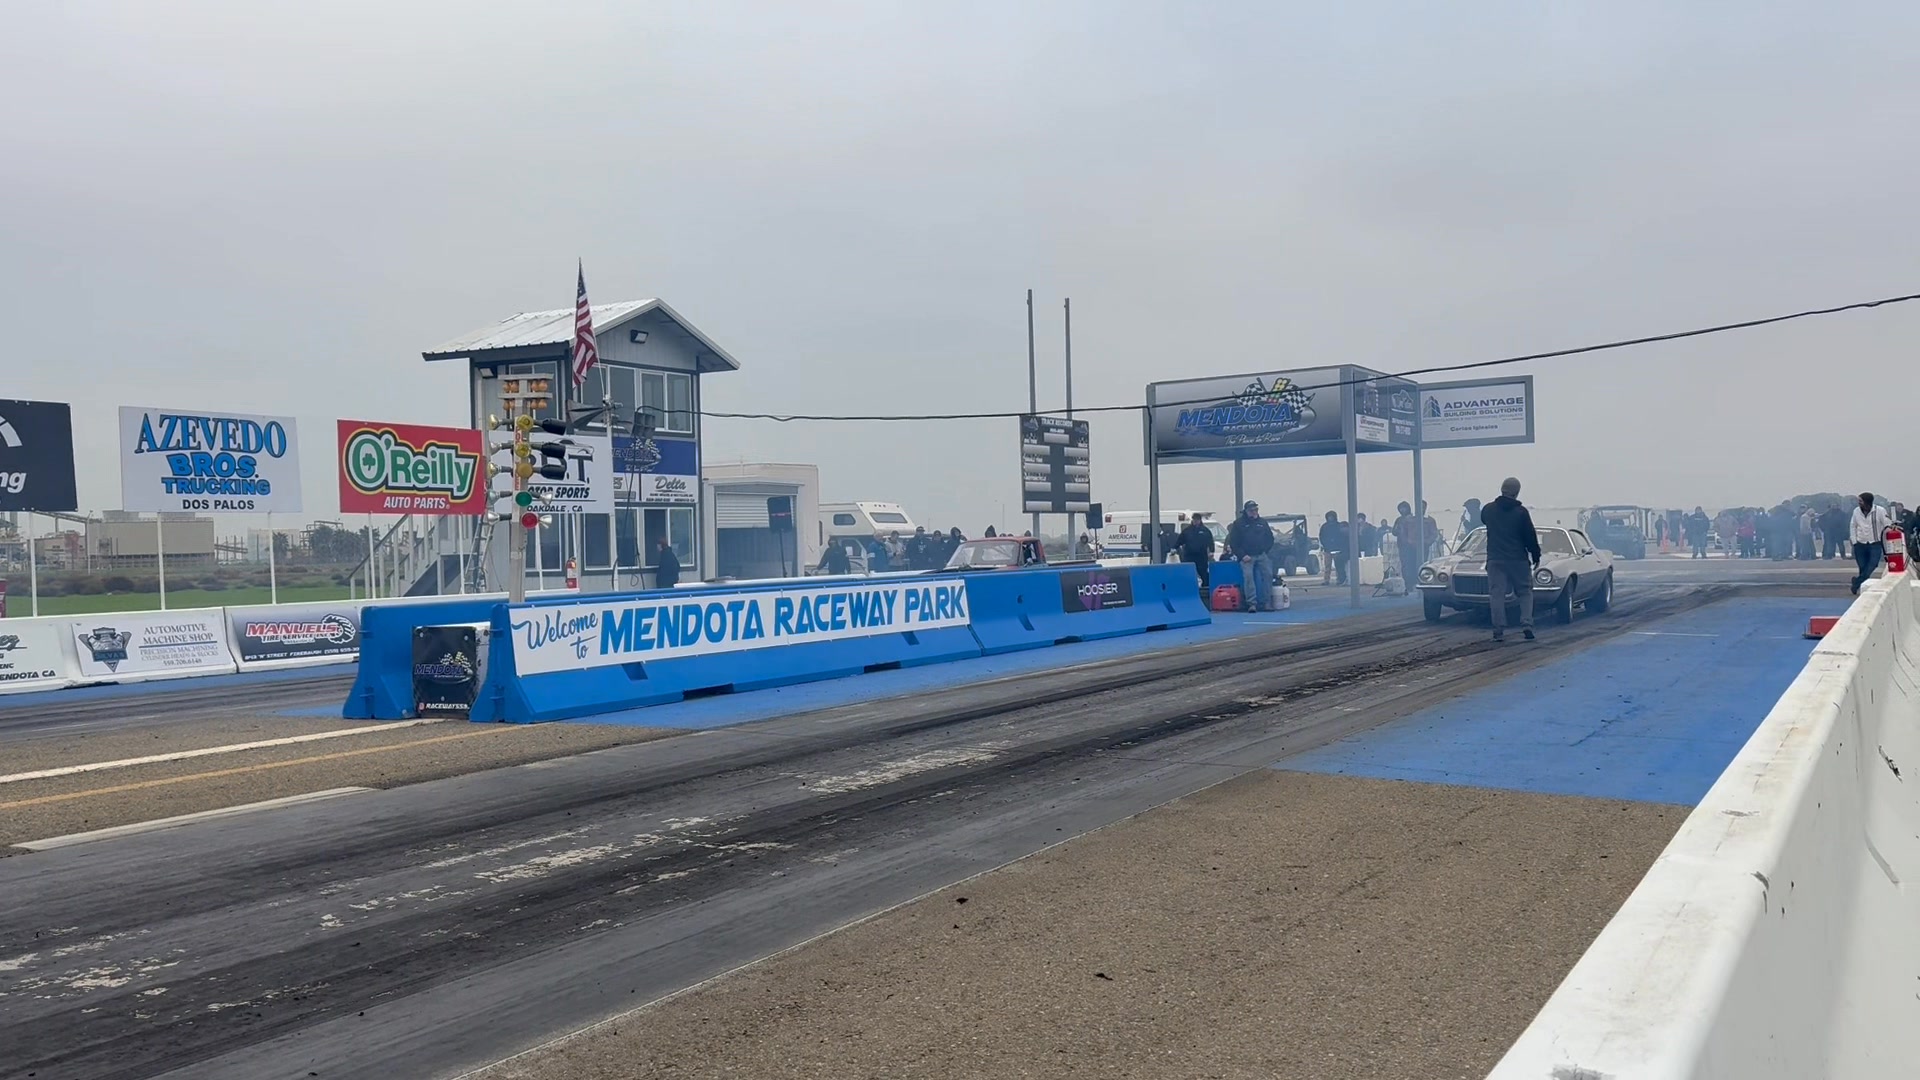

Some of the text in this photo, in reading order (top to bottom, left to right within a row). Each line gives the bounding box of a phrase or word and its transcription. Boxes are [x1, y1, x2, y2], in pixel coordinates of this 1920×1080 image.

[1443, 396, 1524, 410] ADVANTAGE
[1175, 402, 1293, 429] MENDOTA
[1443, 410, 1477, 418] BUILDING
[1479, 407, 1524, 415] SOLUTIONS
[1223, 420, 1299, 431] RACEWAY PARK
[135, 413, 287, 459] AZEVEDO
[166, 451, 259, 479] BROS.
[350, 435, 473, 495] O'Reilly
[161, 477, 271, 496] TRUCKING
[654, 476, 687, 490] Delta
[554, 487, 590, 499] SPORTS
[182, 499, 255, 510] DOS PALOS
[383, 496, 411, 508] AUTO
[1077, 583, 1118, 597] HOOSIER
[600, 585, 966, 656] MENDOTA RACEWAY PARK
[144, 623, 207, 635] AUTOMOTIVE
[247, 623, 338, 637] MANUELS
[511, 609, 599, 650] Welcome
[143, 632, 214, 645] MACHINE SHOP
[262, 635, 280, 643] TIRE
[282, 633, 314, 641] SERVICE
[569, 634, 598, 660] to
[42, 669, 56, 677] CA
[414, 663, 465, 675] MENDOTA
